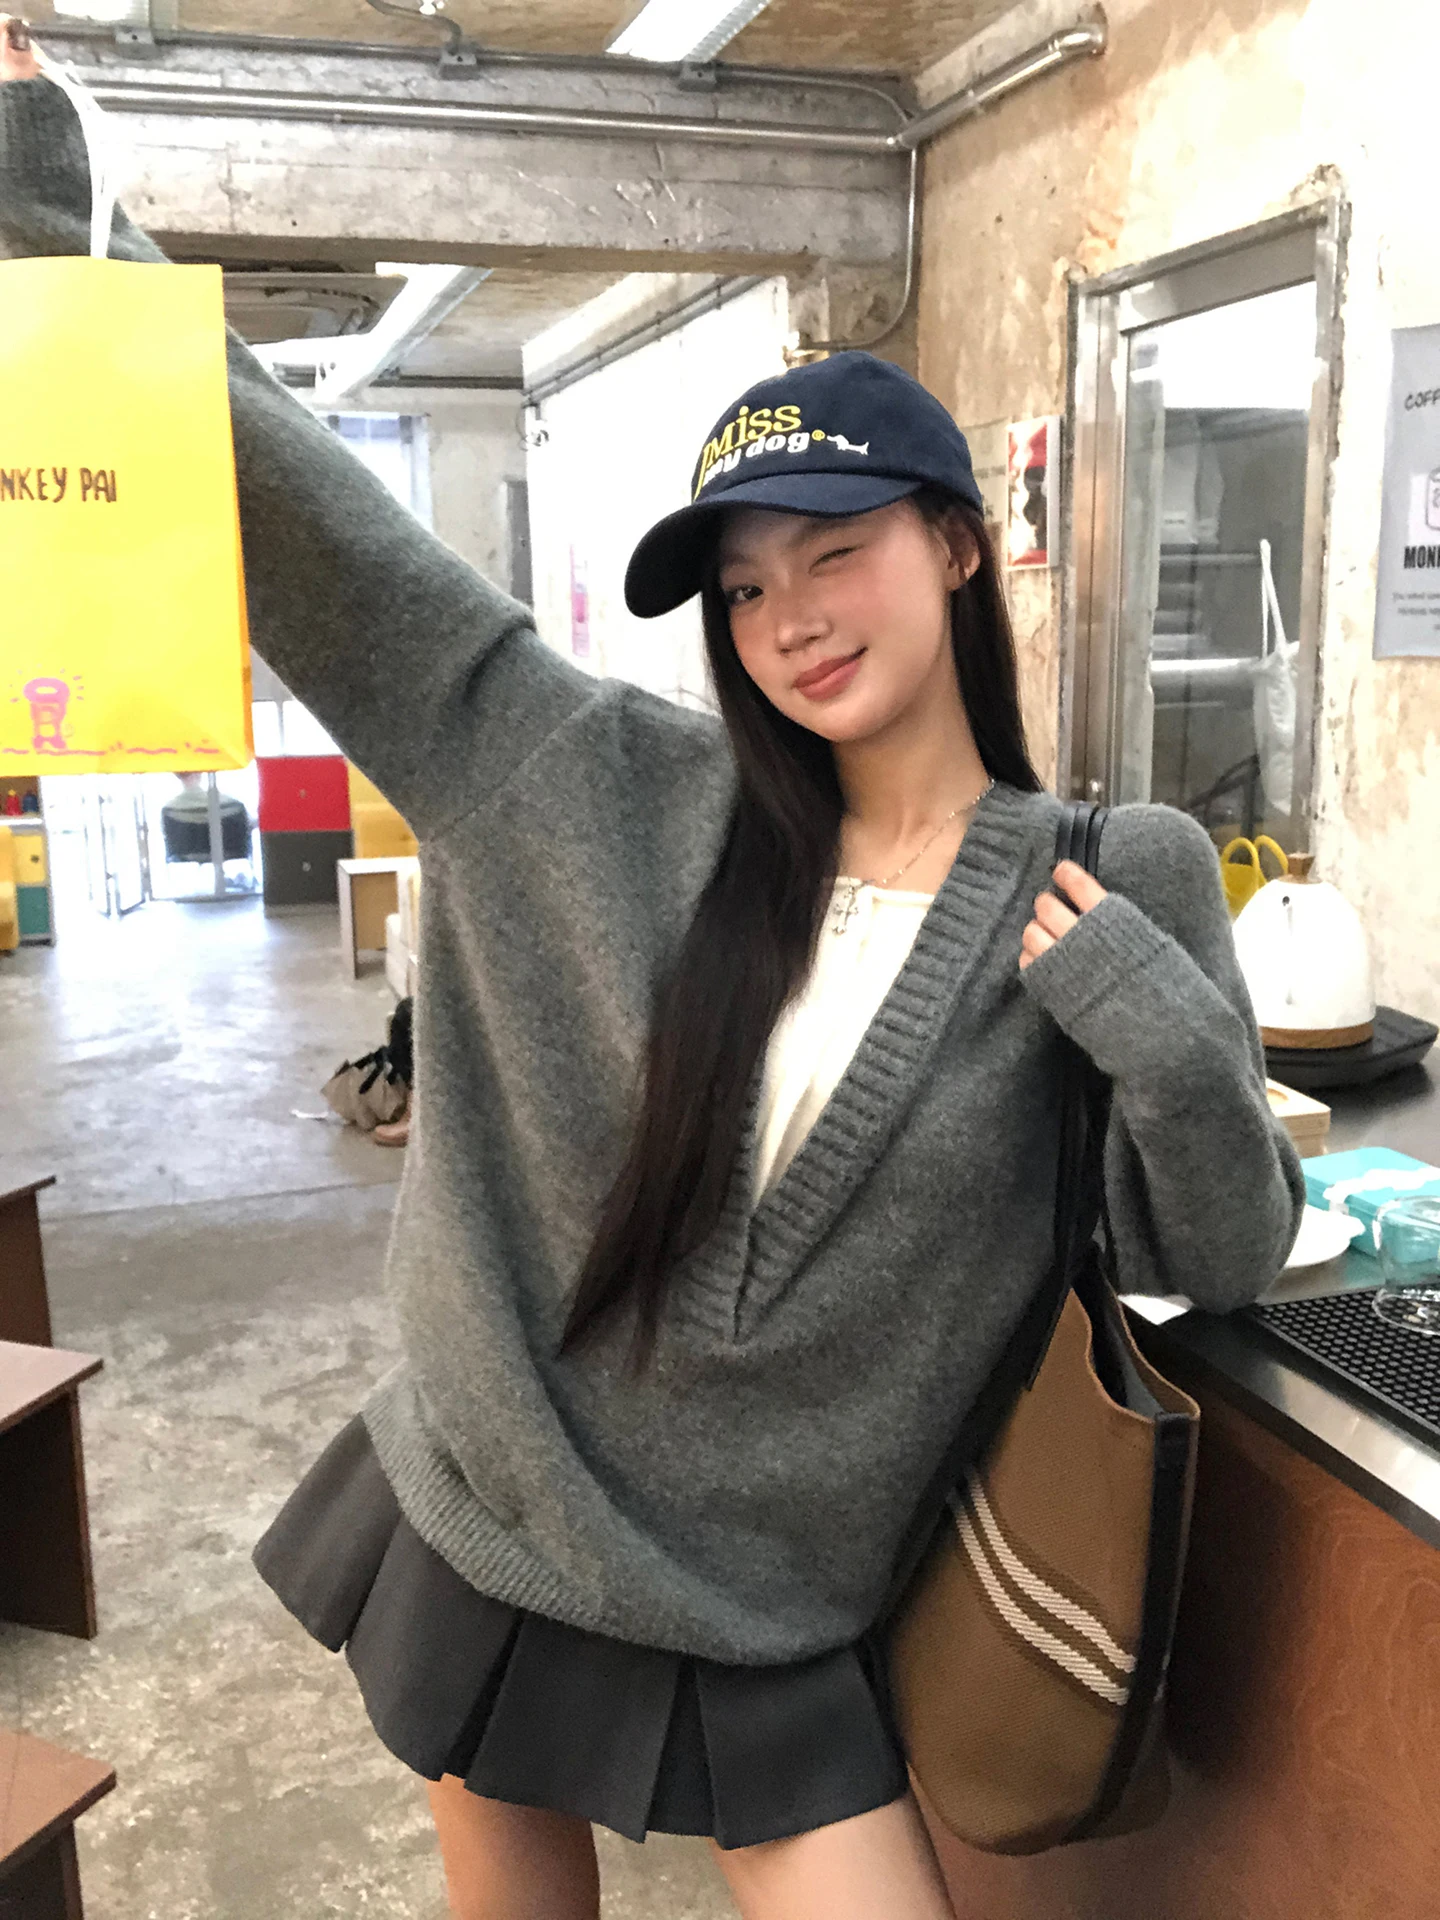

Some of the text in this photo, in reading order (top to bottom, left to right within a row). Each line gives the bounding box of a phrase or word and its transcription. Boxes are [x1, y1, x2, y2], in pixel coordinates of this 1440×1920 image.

[694, 405, 802, 501] Miss
[746, 432, 811, 458] dog
[80, 467, 117, 503] PAI
